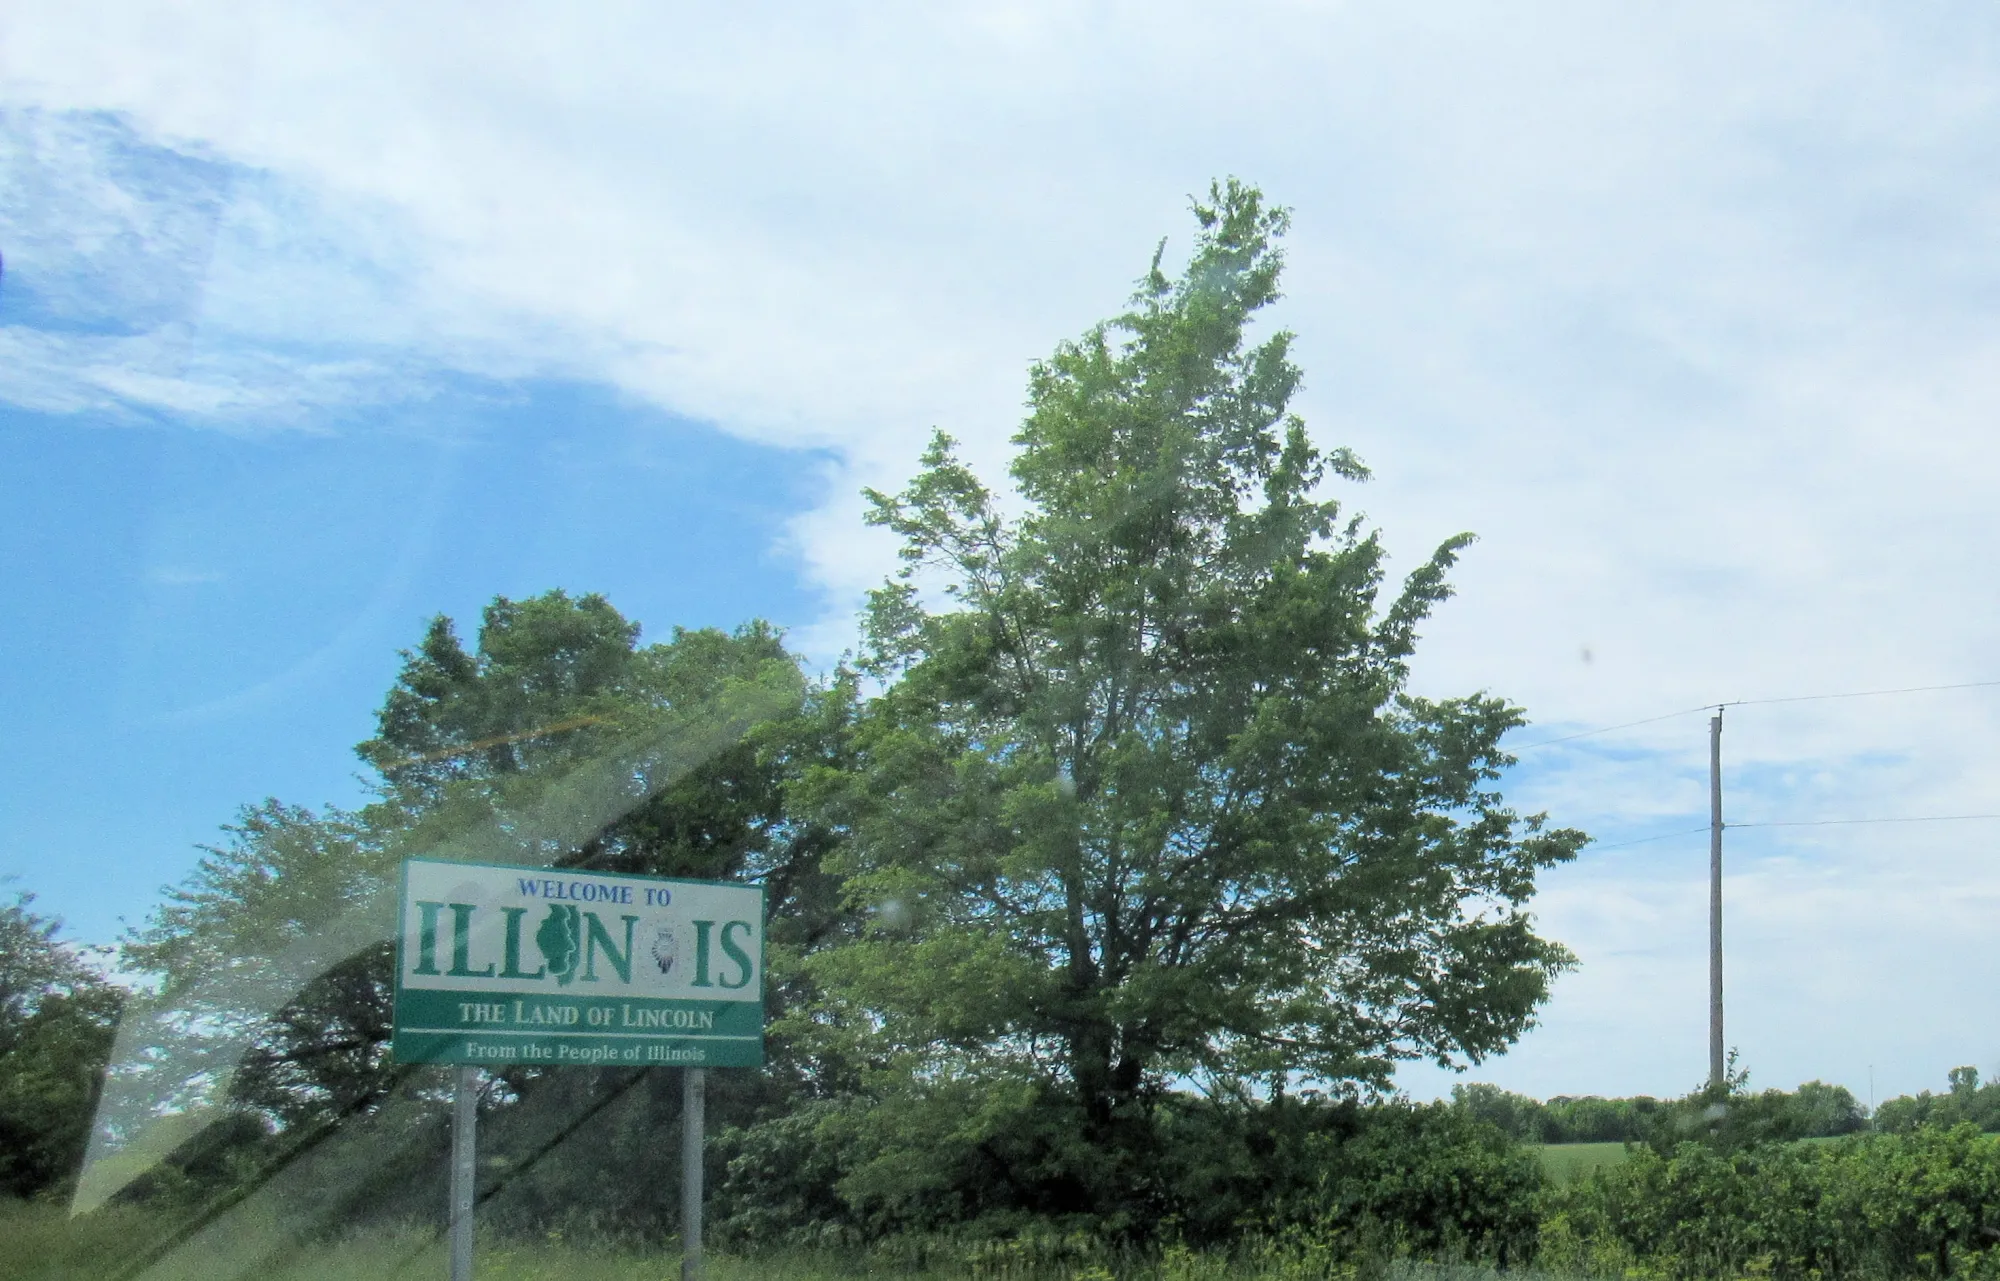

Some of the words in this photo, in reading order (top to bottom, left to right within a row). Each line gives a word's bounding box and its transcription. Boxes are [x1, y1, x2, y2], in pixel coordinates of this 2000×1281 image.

[518, 878, 633, 904] WELCOME
[644, 888, 672, 907] TO
[412, 901, 753, 989] ILLNIS
[459, 1003, 506, 1023] THE
[514, 1000, 580, 1025] LAND
[587, 1006, 616, 1026] OF
[621, 1004, 714, 1029] LINCOLN
[466, 1041, 517, 1059] From
[523, 1043, 552, 1059] the
[559, 1045, 619, 1063] People
[624, 1045, 642, 1060] of
[647, 1045, 706, 1061] Illinois
